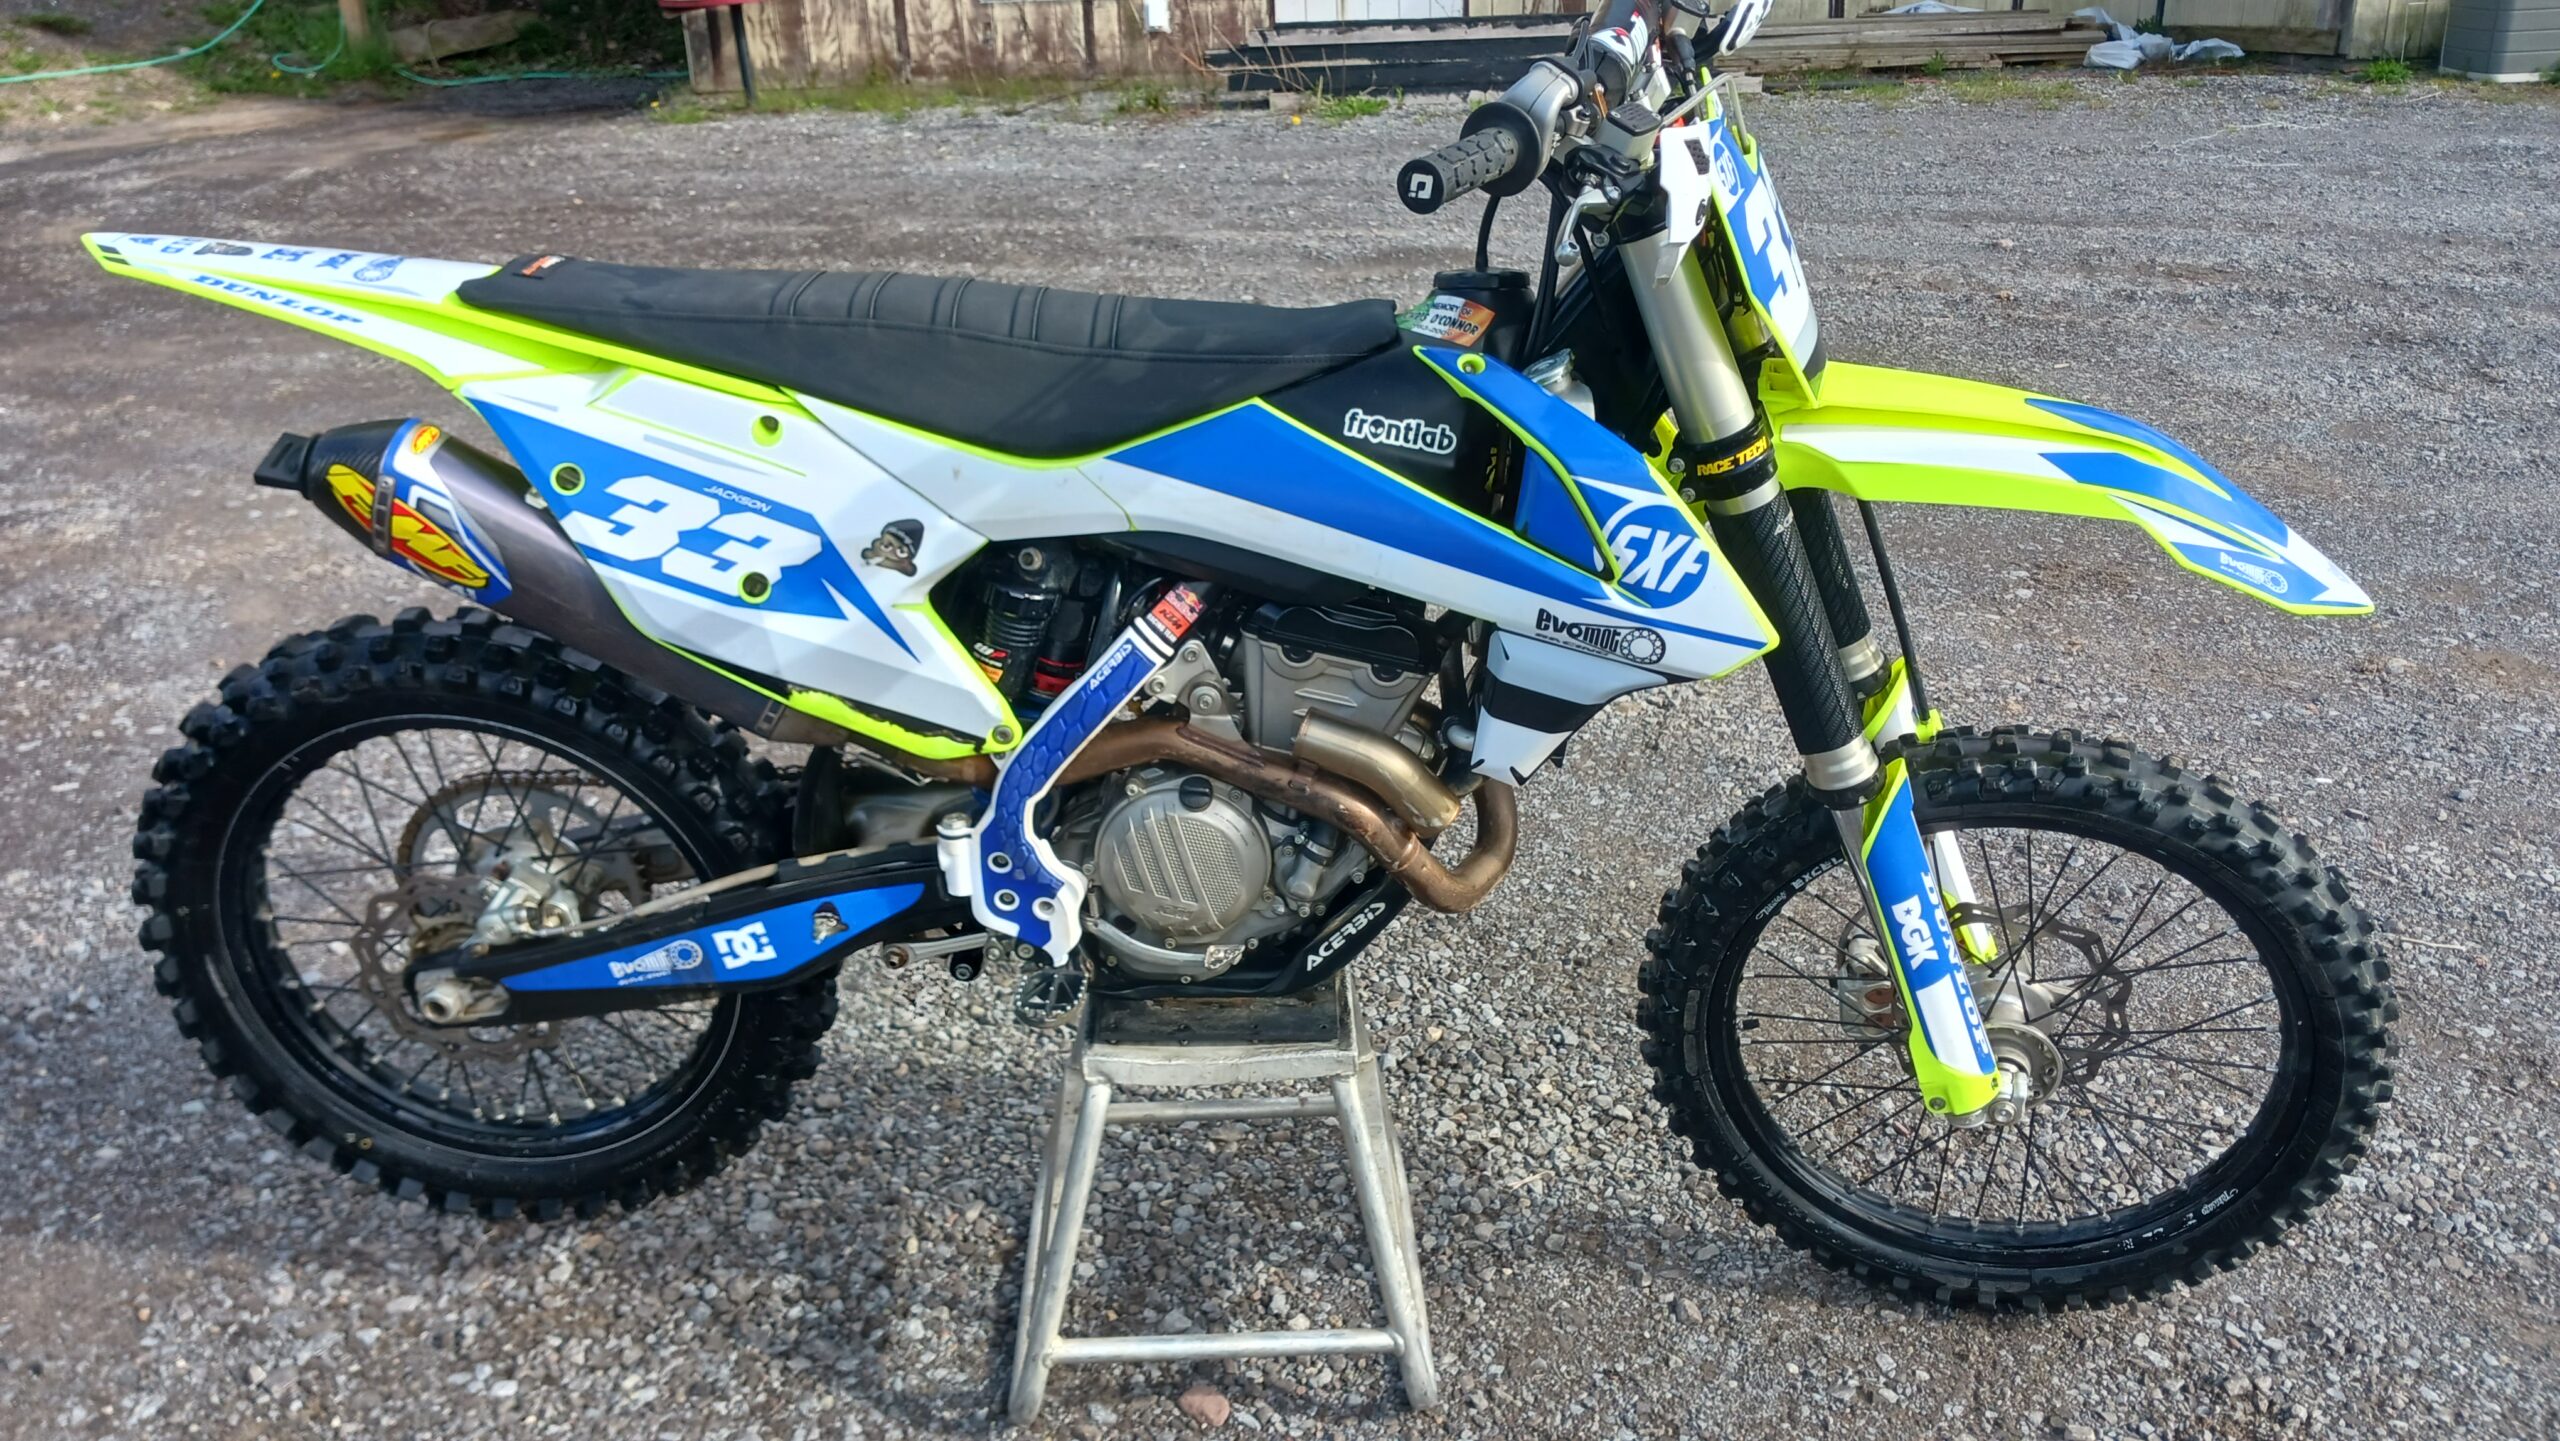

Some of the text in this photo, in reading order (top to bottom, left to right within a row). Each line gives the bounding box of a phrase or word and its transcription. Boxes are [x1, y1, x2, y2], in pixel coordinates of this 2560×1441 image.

[190, 275, 363, 324] DUNLOP
[1343, 408, 1457, 455] frontlab
[1696, 435, 1769, 477] RACE TECH
[702, 485, 773, 513] JACKSON
[559, 475, 823, 597] 33
[1609, 523, 1704, 595] SXF
[1159, 608, 1183, 630] KTM
[1790, 857, 1844, 890] EXCEL
[711, 920, 778, 970] DC
[1306, 902, 1387, 972] ACERBIS
[1891, 894, 1940, 971] DGK
[1921, 871, 1990, 1056] DUNLOP
